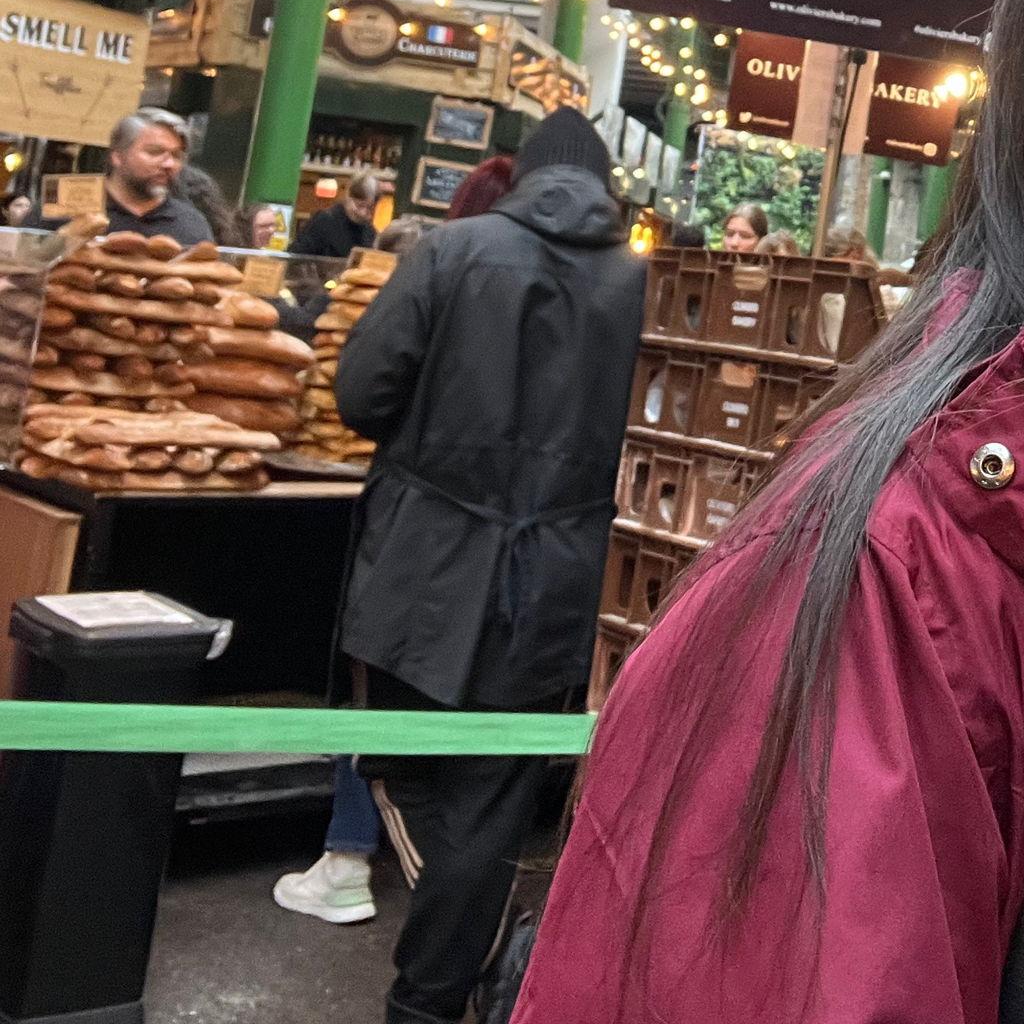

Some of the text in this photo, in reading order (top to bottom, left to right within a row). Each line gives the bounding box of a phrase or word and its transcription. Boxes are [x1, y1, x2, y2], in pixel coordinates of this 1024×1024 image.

[0, 12, 135, 65] SMELL ME
[869, 82, 943, 109] AKERY
